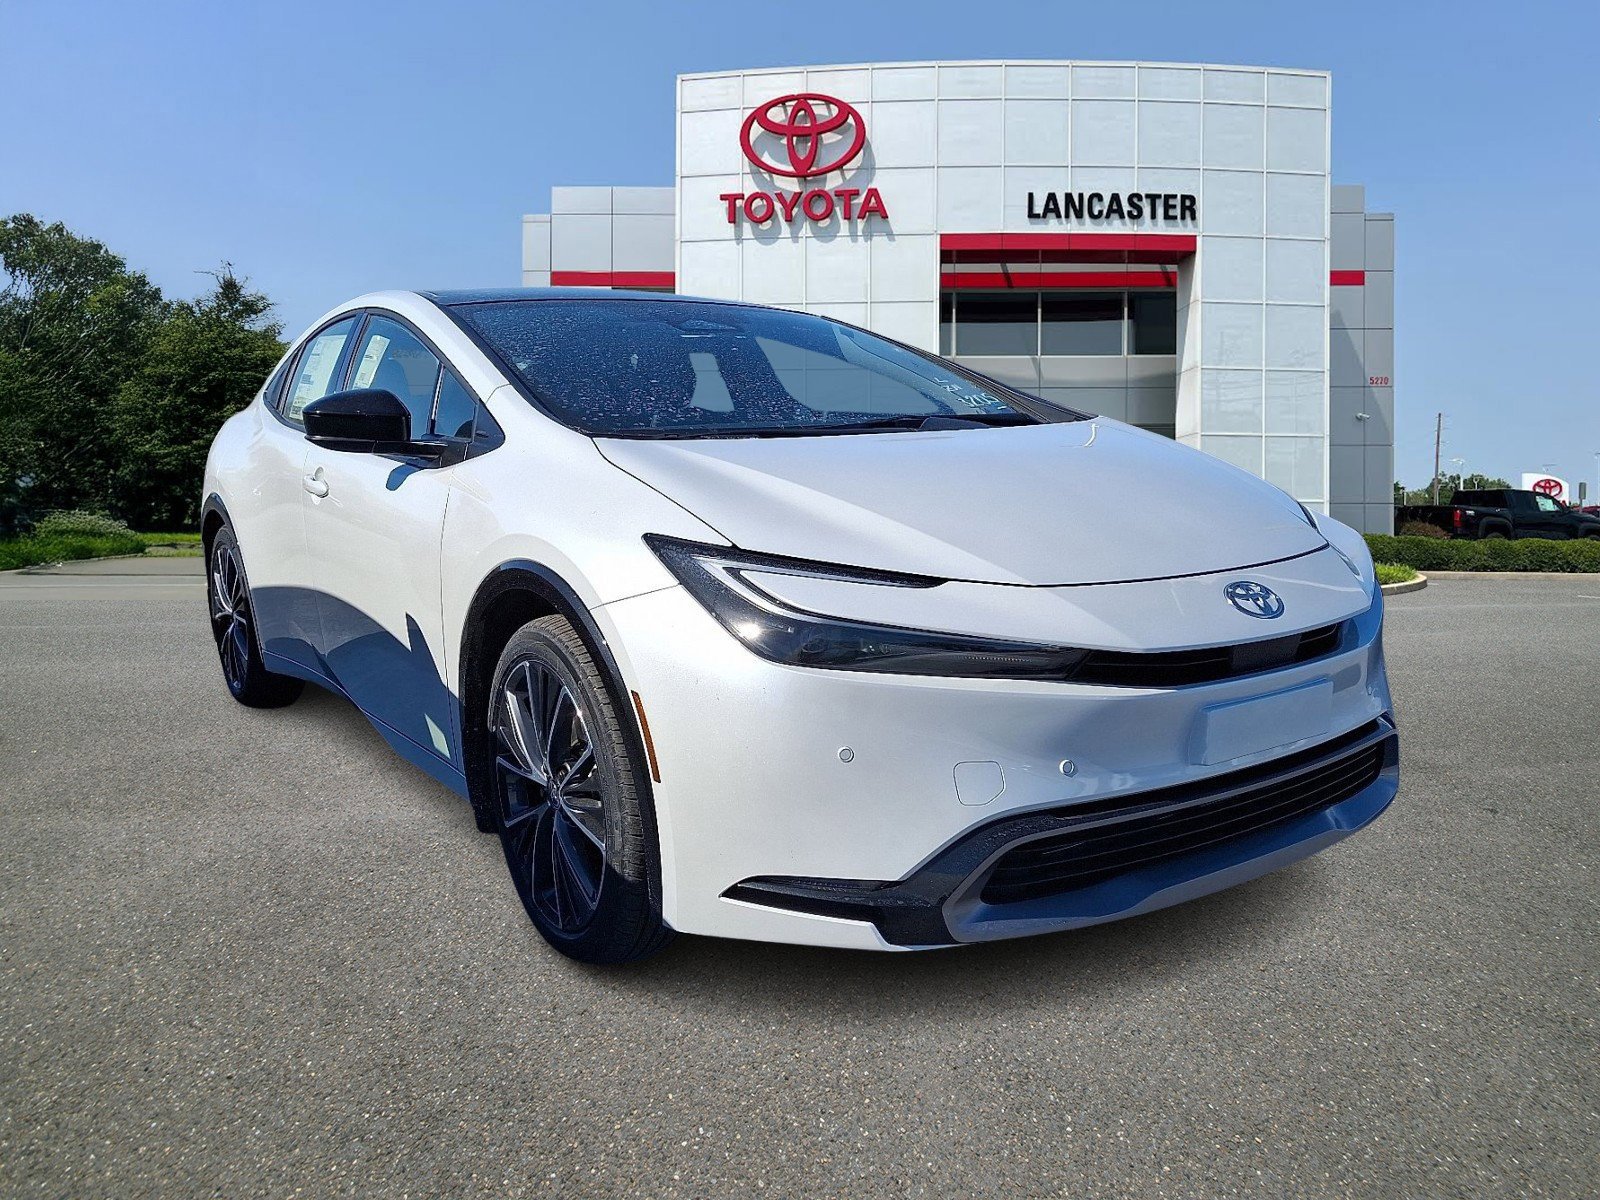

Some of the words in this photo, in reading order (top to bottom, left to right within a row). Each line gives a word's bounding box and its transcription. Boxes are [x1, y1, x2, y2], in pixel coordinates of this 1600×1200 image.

[720, 188, 889, 224] TOYOTA
[1027, 192, 1197, 221] LANCASTER
[1369, 376, 1389, 385] 5270
